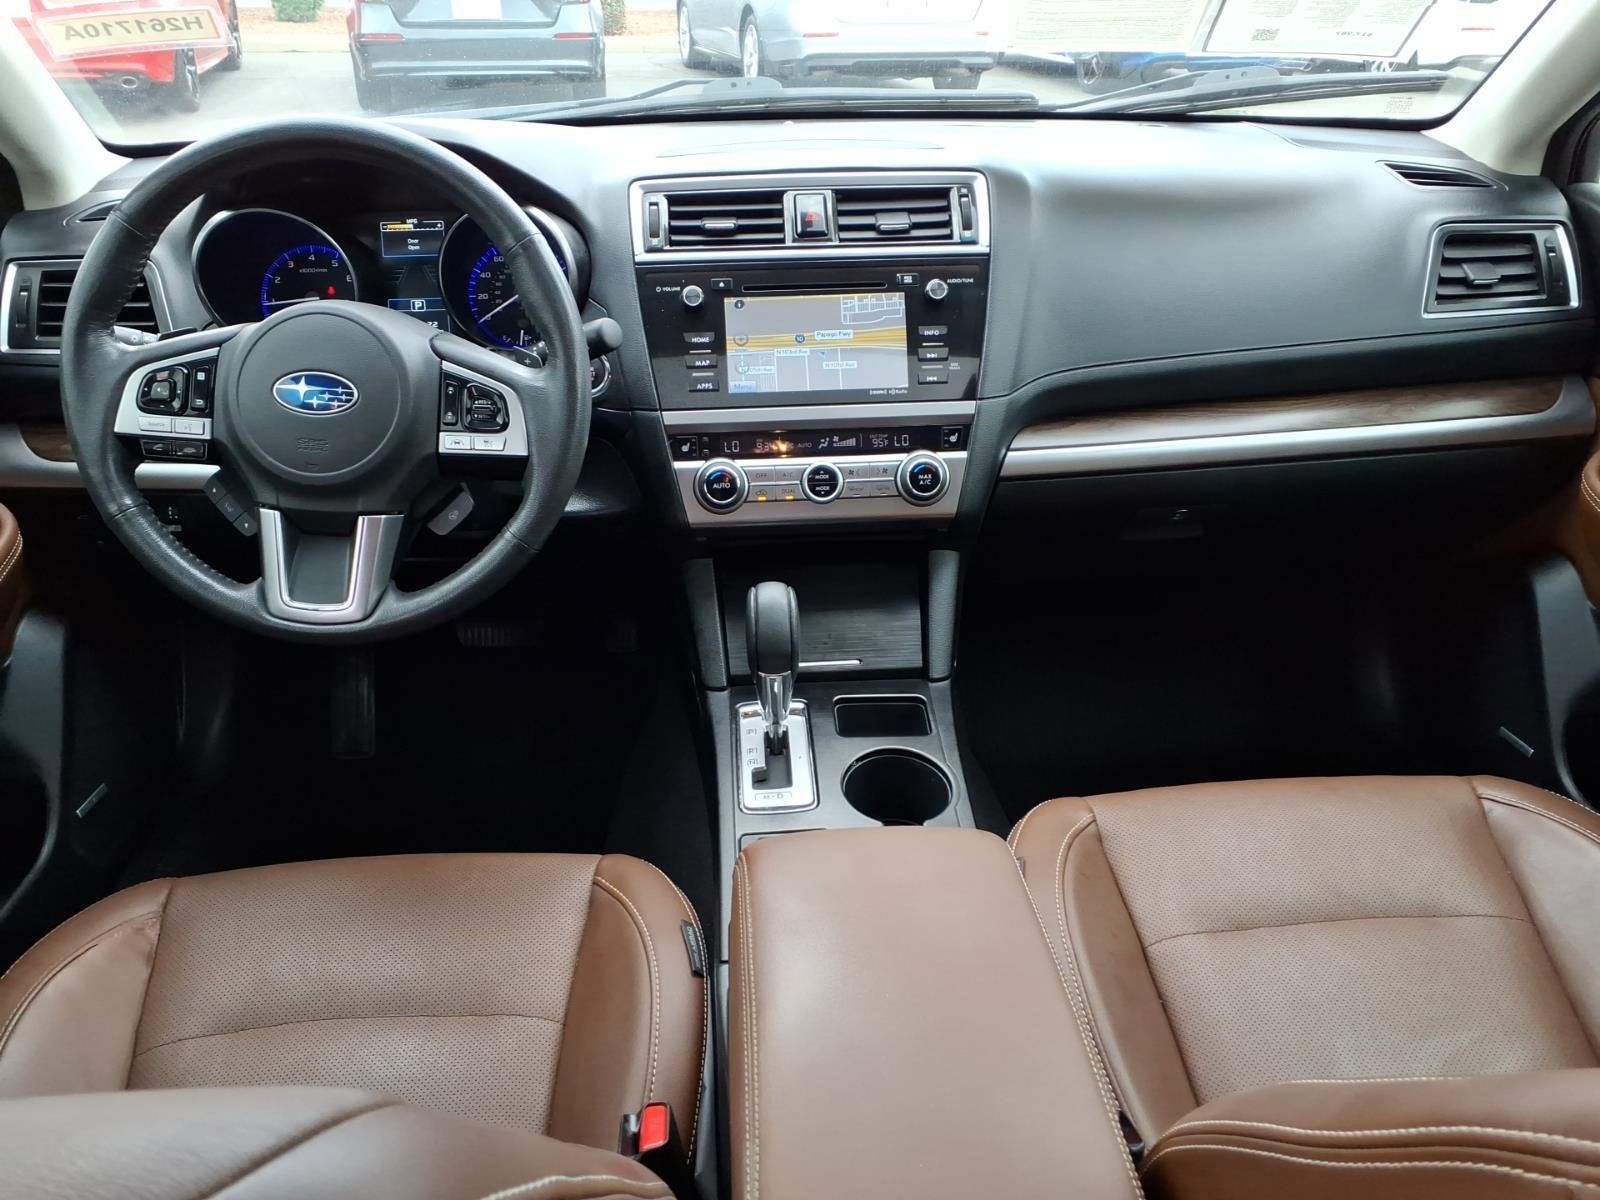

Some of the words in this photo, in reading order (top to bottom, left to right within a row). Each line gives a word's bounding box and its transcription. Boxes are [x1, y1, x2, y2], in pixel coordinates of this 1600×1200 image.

[274, 276, 281, 284] 2
[414, 301, 423, 310] P
[894, 434, 909, 447] LO
[724, 440, 740, 453] LO
